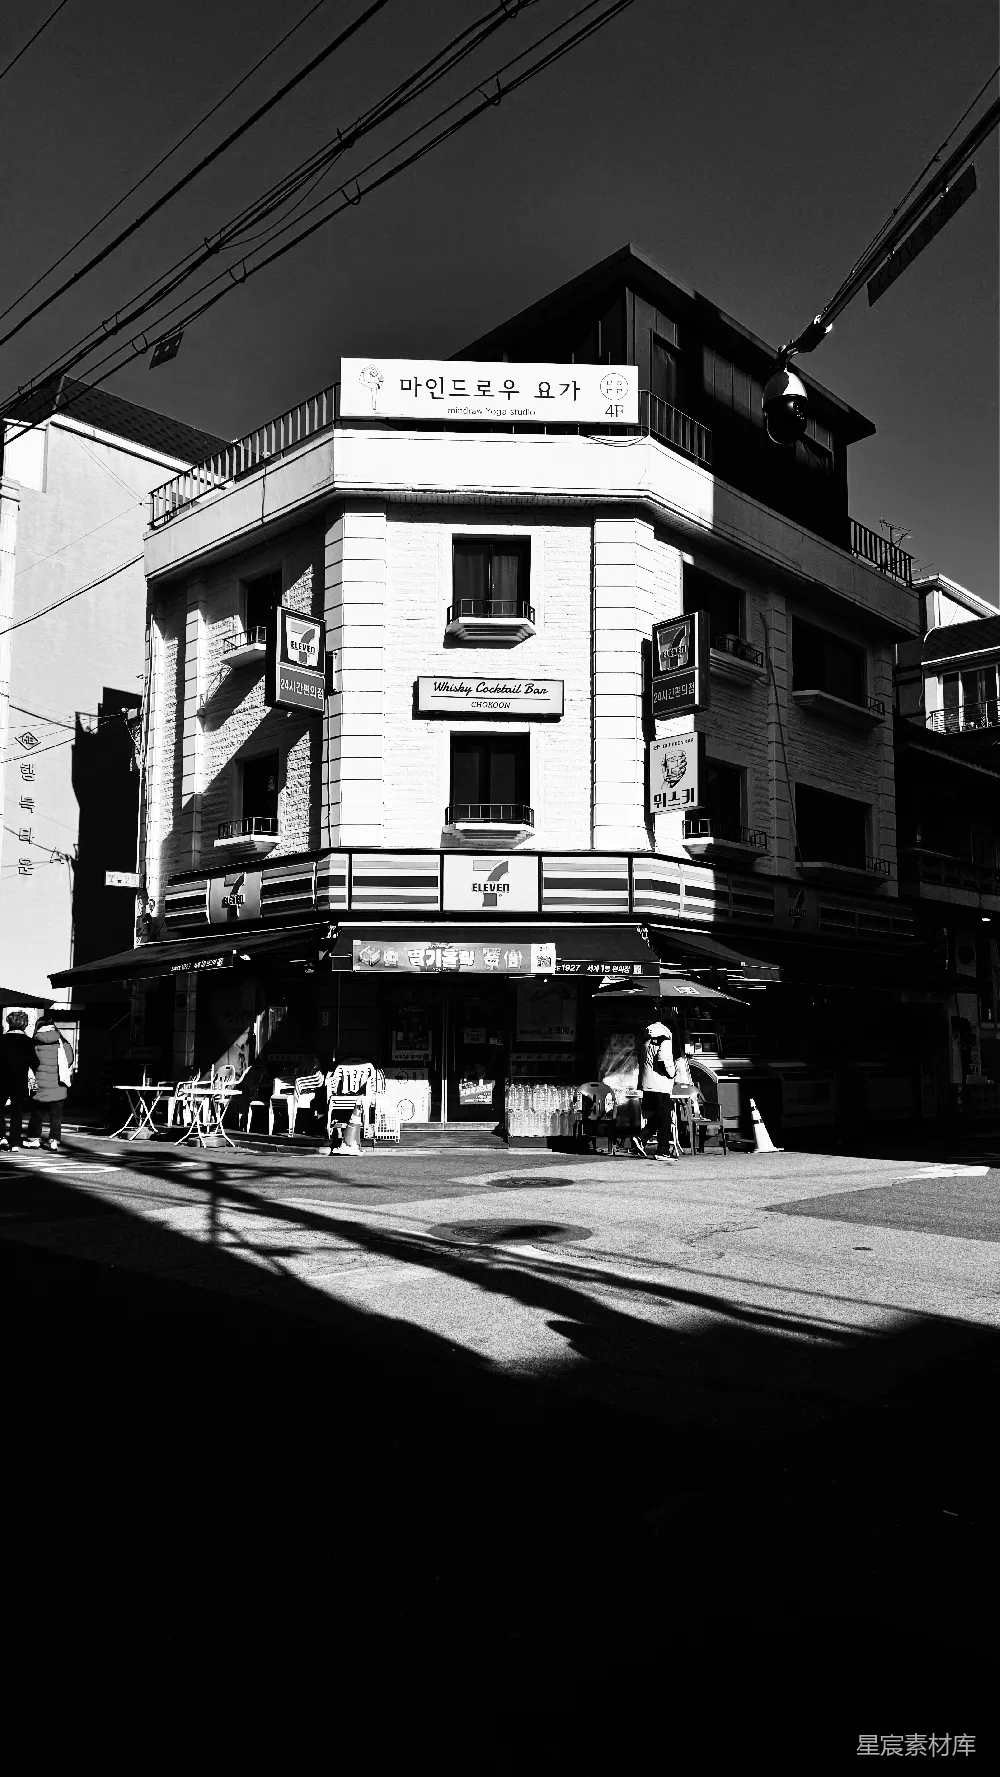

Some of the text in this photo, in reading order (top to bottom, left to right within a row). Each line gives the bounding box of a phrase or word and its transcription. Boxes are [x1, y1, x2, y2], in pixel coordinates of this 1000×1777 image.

[399, 376, 520, 400] 마인드로우
[533, 380, 581, 401] 요가
[485, 407, 507, 417] Yoga
[510, 408, 537, 416] studio
[605, 405, 624, 418] 4F
[280, 678, 324, 700] 24시간편의점
[433, 681, 549, 696] Whisky Cocktail Bar
[470, 701, 511, 709] CHOKOON
[653, 788, 695, 808] 위스키
